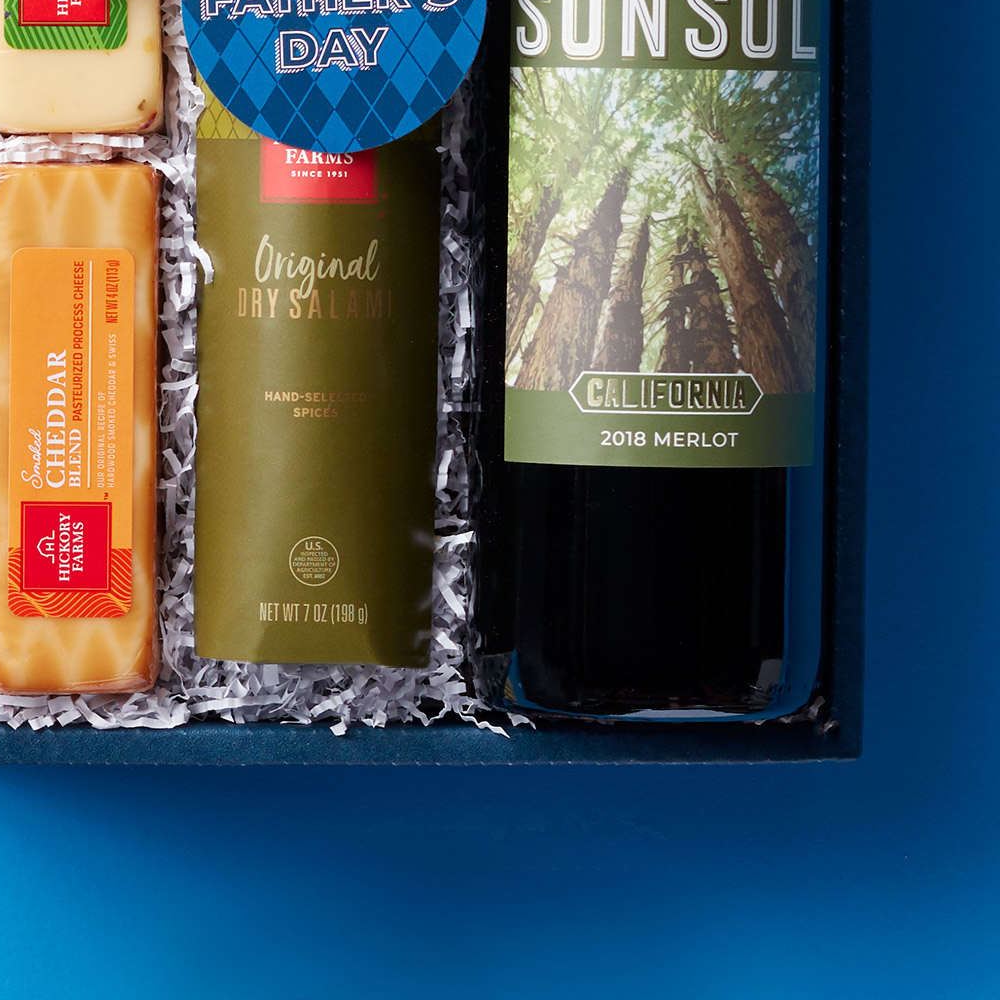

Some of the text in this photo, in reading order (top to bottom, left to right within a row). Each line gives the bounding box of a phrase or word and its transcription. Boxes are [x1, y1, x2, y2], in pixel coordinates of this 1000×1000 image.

[275, 26, 389, 74] DAY
[285, 149, 354, 165] FARMS
[290, 170, 348, 178] SINCE 1951
[105, 267, 120, 282] (113
[106, 259, 120, 267] g)
[255, 234, 381, 299] Original
[105, 283, 118, 292] OZ
[105, 299, 118, 310] WT
[105, 310, 118, 324] NET
[238, 287, 393, 319] DRY SALAMI
[108, 333, 117, 359] SWISS
[69, 260, 84, 488] BLEND PASTEURIZED PROCESS CHEESE
[108, 369, 117, 406] CHEDDAR
[264, 391, 367, 403] HAND-SELECTED
[586, 376, 748, 411] CALIFORNIA
[46, 349, 67, 488] CHEDDAR
[107, 408, 117, 441] SMOKED
[293, 407, 339, 418] SPICES
[96, 391, 106, 488] OUR ORIGINAL RECIPE OF
[600, 429, 739, 449] 2018 MERLOT
[21, 428, 43, 489] Smoked
[107, 443, 116, 488] HARDWOOD
[59, 512, 71, 582] HICKORY
[72, 521, 84, 572] FARMS
[305, 541, 324, 551] U.S.
[259, 602, 368, 625] NET WT 7 OZ (198 g)
